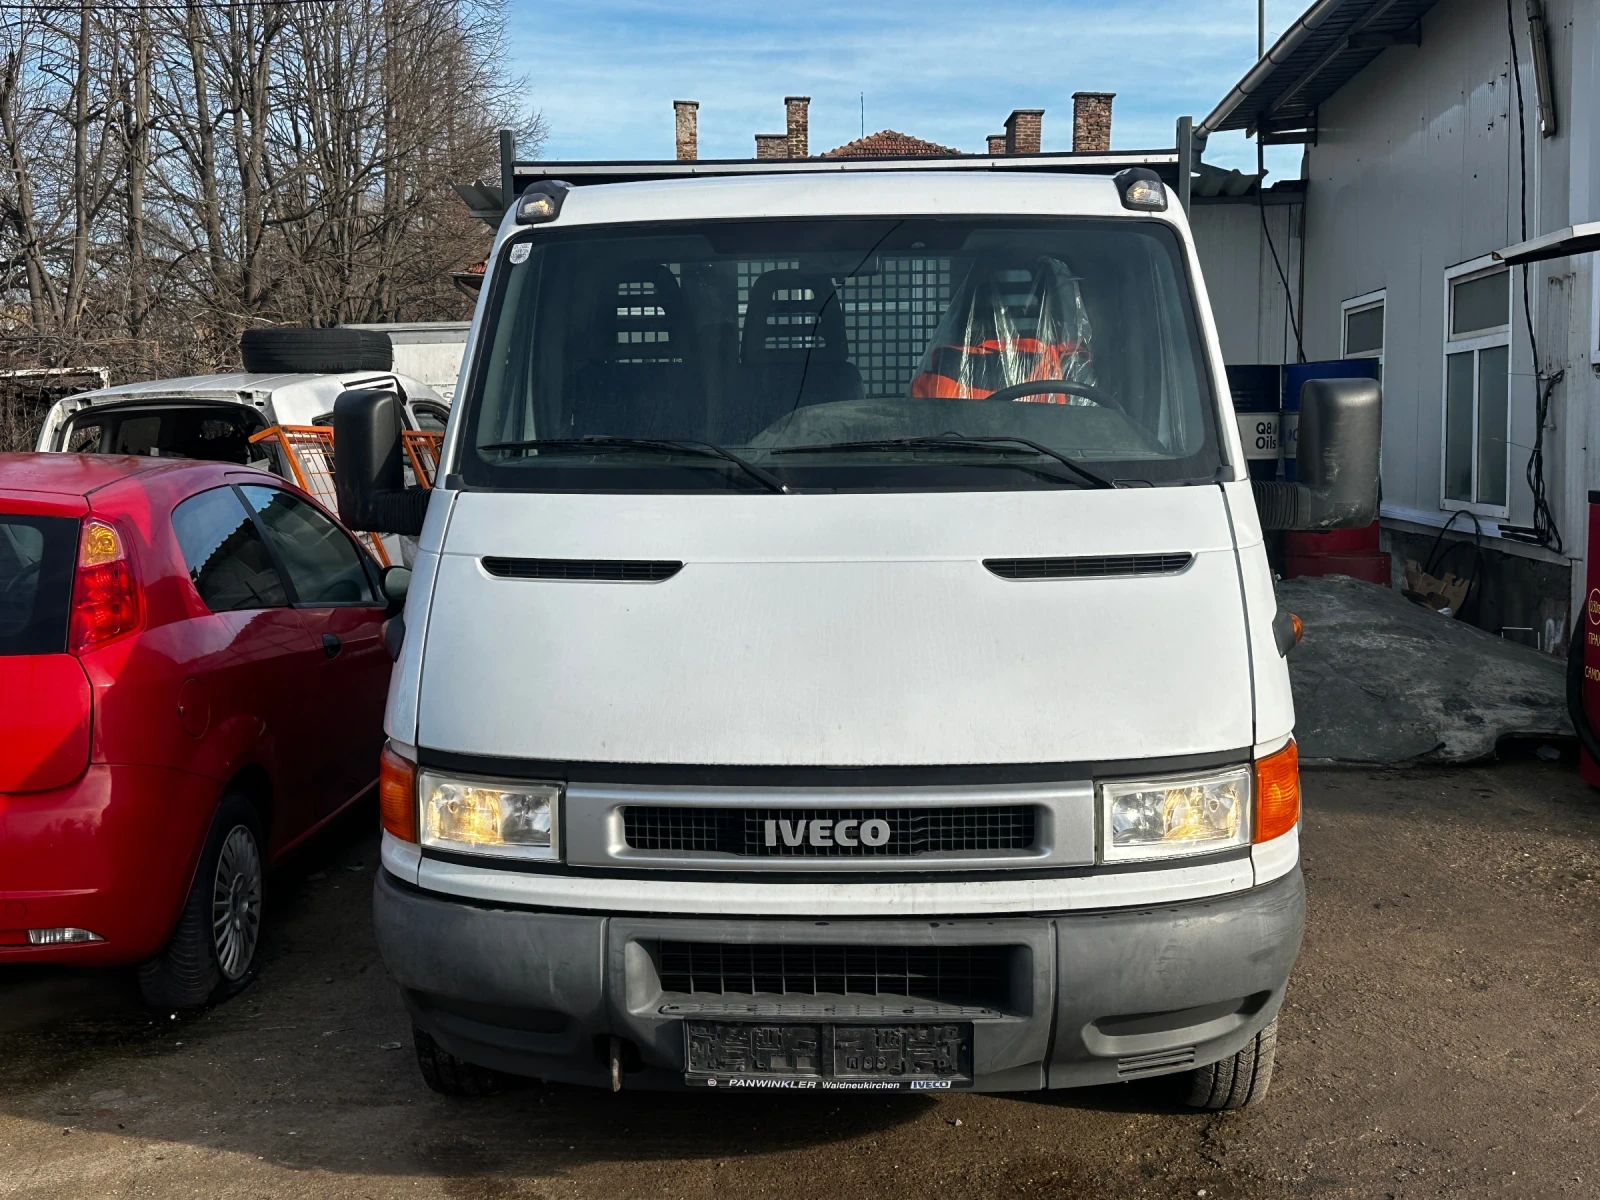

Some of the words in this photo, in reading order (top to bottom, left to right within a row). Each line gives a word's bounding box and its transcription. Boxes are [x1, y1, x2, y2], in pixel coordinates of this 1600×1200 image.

[1256, 421, 1272, 435] Q8
[1255, 436, 1277, 450] Oils
[764, 819, 891, 847] IVECO
[728, 1079, 817, 1089] PANWINKLER
[822, 1081, 900, 1090] Waldneukirchen
[911, 1080, 952, 1090] IVECO
